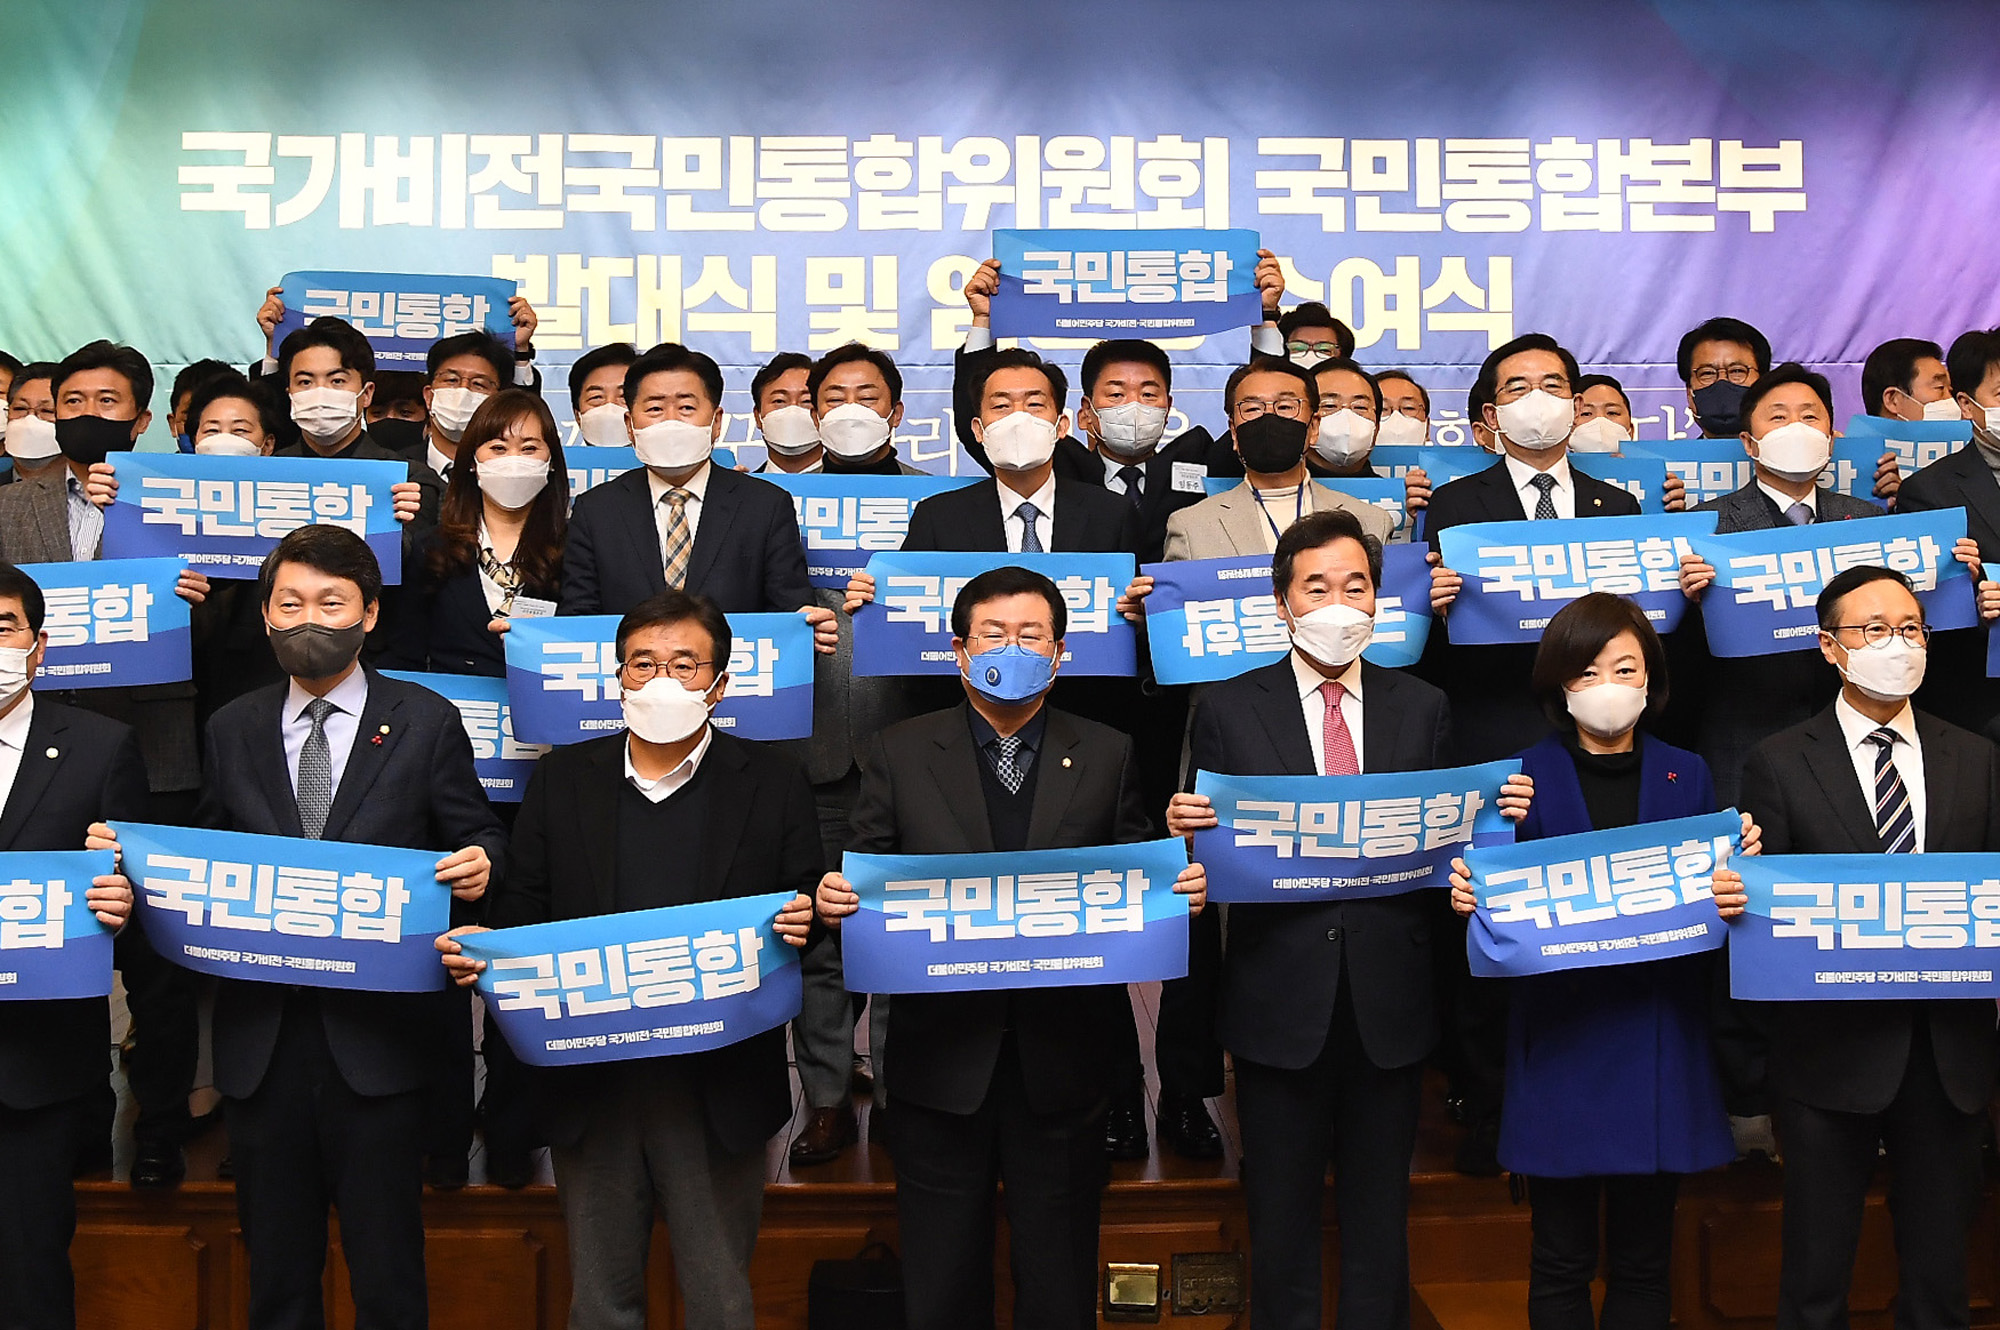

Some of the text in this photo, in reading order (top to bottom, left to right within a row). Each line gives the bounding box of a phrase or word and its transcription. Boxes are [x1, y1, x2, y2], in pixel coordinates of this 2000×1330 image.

[178, 131, 1807, 233] 국가비전국민통합위원회 국민통합본부
[492, 253, 777, 352] 발대식
[805, 254, 899, 350] 및
[1022, 250, 1233, 303] 국민통합
[303, 289, 490, 339] 국민통합
[141, 477, 373, 540] 국민통합
[1478, 537, 1693, 601] 국민통합
[885, 576, 1116, 633] 국합
[541, 638, 779, 702] 국합
[1233, 790, 1485, 859] 국민통합
[143, 854, 410, 943] 국민통합
[883, 869, 1150, 942] 국민통합
[1272, 877, 1330, 889] 더불어민주당
[1485, 835, 1734, 929] 국민통합
[183, 945, 240, 964] 더불어민주당
[492, 927, 763, 1020] 국민통합
[927, 962, 988, 976] 더불어민주당
[1815, 971, 1876, 983] 더불어민주당
[546, 1034, 607, 1050] 더불어민주당
